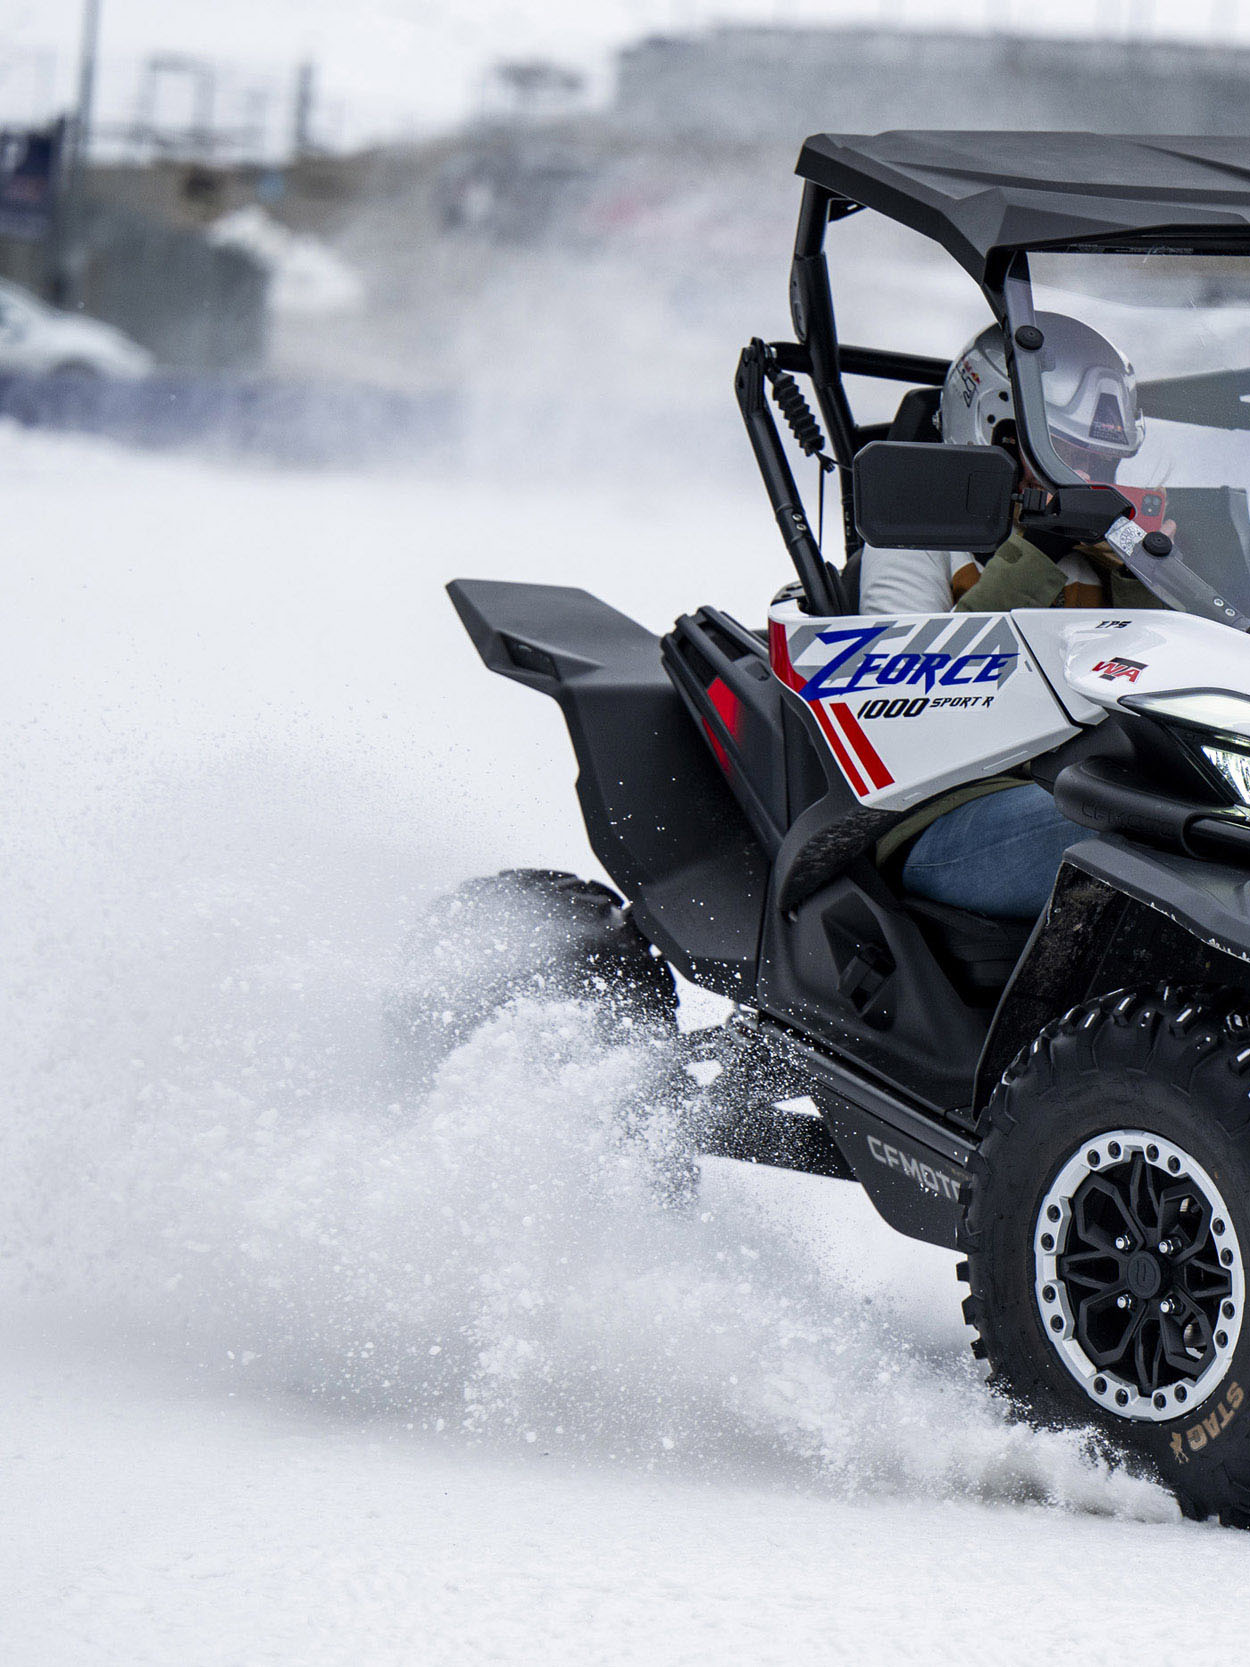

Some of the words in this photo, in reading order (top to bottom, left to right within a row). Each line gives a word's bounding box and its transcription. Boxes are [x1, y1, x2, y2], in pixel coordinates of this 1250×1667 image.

[1095, 620, 1132, 629] EPS
[856, 697, 931, 720] 1000
[929, 696, 984, 708] SPORT
[982, 695, 995, 708] R
[1185, 1381, 1245, 1452] STAG
